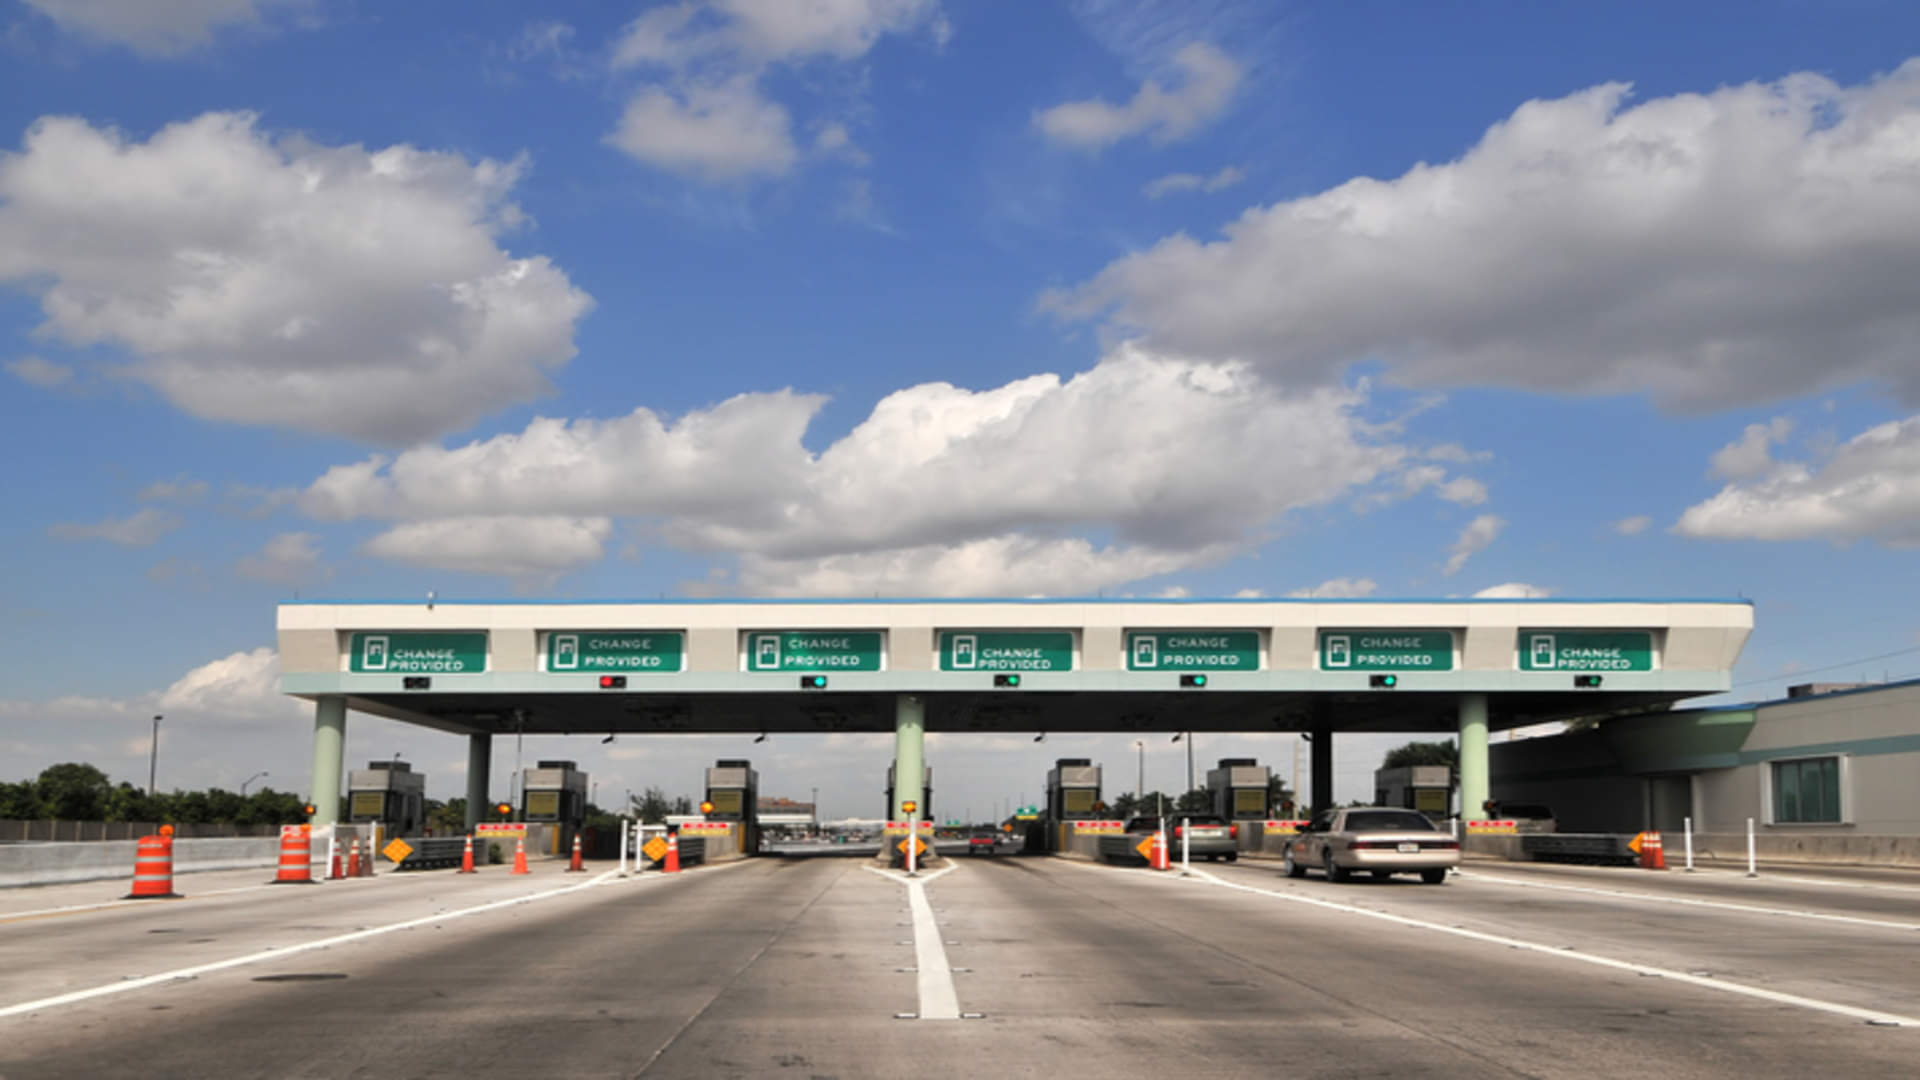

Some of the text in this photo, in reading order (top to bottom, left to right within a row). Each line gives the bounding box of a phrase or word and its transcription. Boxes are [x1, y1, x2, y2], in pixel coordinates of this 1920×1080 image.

[589, 638, 651, 650] CHANGE
[788, 638, 851, 650] CHANGE
[1168, 638, 1229, 649] CHANGE
[1360, 638, 1422, 649] CHANGE
[393, 648, 455, 660] CHANGE
[982, 648, 1042, 658] CHANGE
[1561, 648, 1621, 658] CHANGE
[389, 660, 464, 671] PROVIDED
[584, 656, 661, 667] PROVIDED
[784, 655, 860, 667] PROVIDED
[978, 659, 1051, 670] PROVIDED
[1163, 655, 1239, 666] PROVIDED
[1356, 655, 1432, 666] PROVIDED
[1558, 659, 1631, 669] PROVIDED
